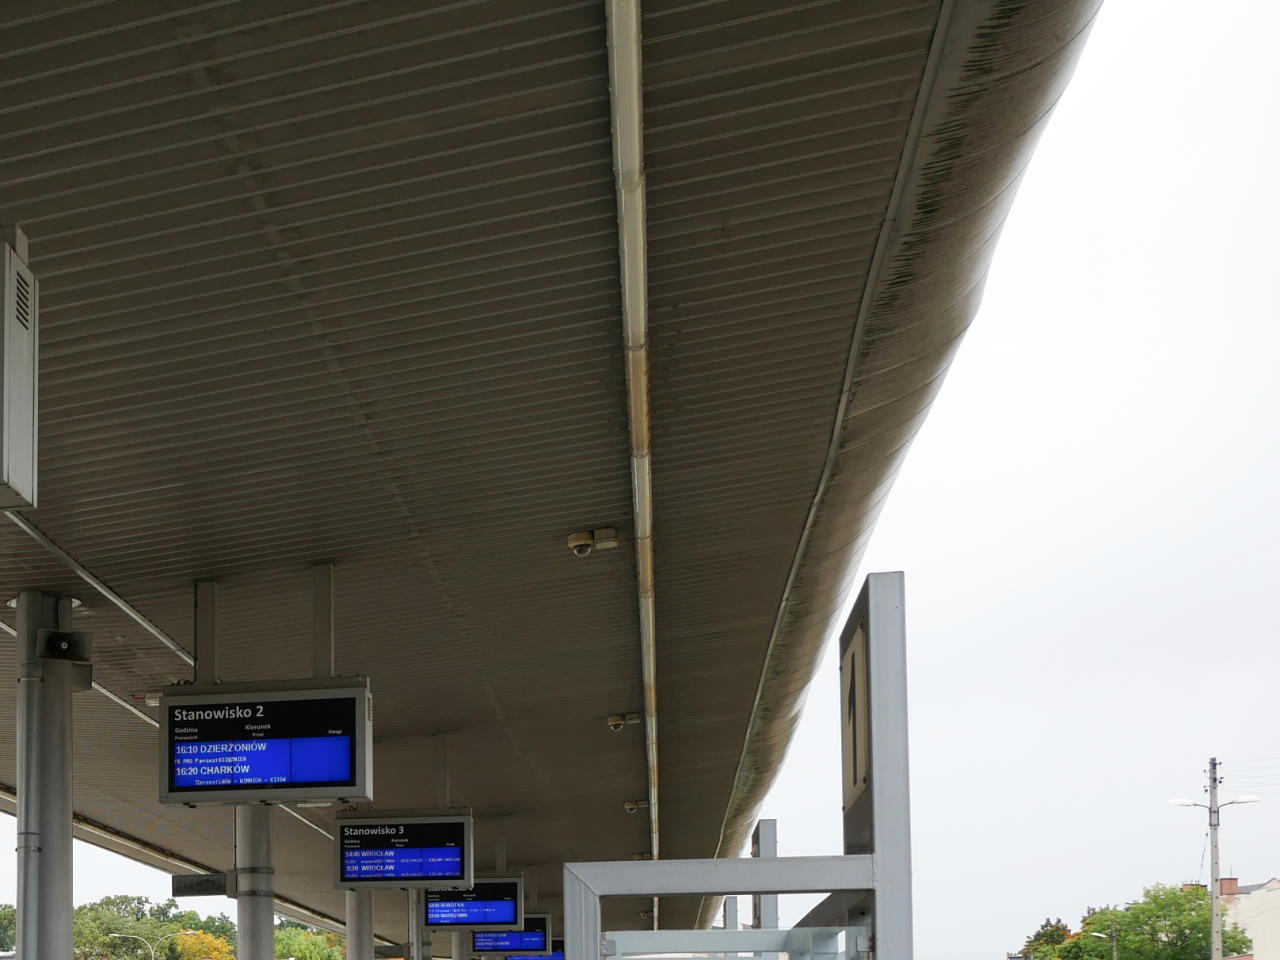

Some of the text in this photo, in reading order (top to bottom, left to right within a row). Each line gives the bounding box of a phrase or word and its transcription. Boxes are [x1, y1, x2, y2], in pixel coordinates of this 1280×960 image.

[174, 705, 264, 721] Stanowisko 2
[175, 741, 267, 754] 16:10 DZIERŻONIÓW
[175, 763, 250, 776] 16:20 CHARKÓW
[344, 826, 404, 836] Stanowisko 3
